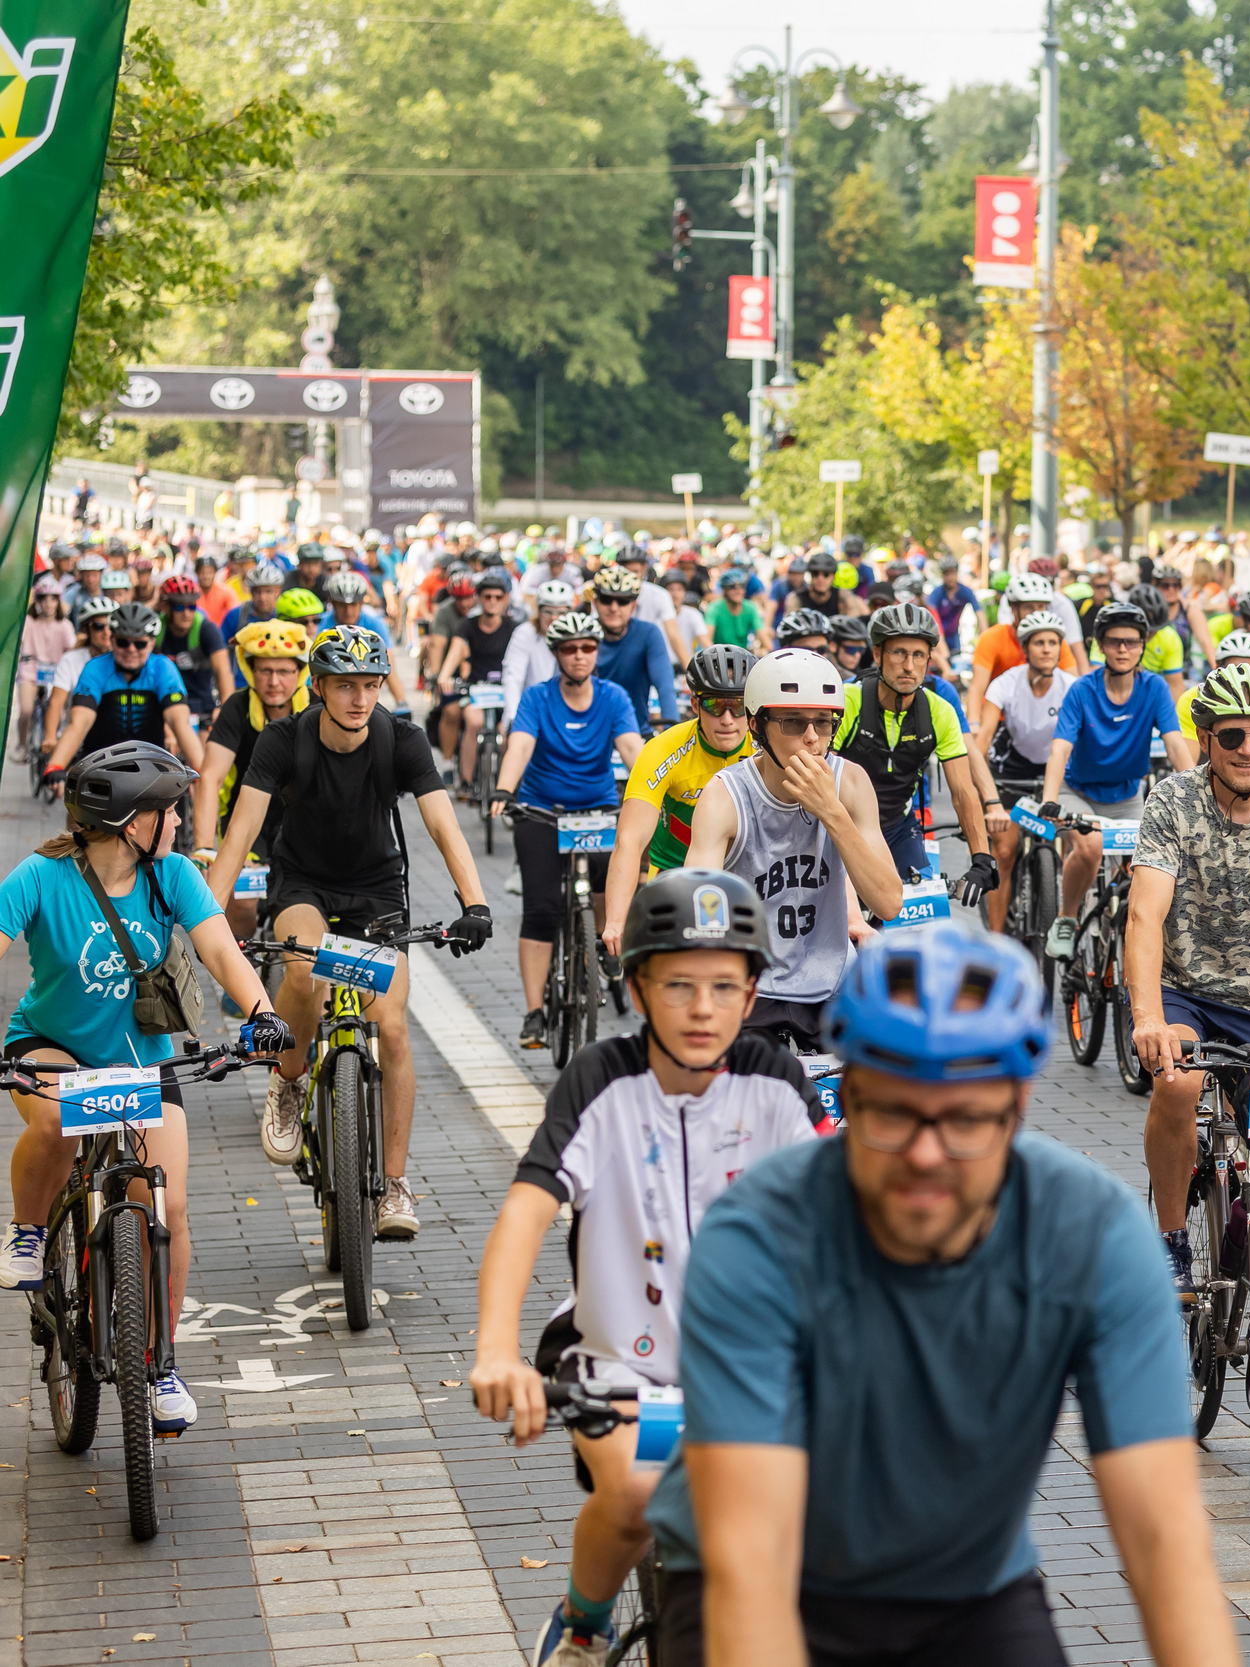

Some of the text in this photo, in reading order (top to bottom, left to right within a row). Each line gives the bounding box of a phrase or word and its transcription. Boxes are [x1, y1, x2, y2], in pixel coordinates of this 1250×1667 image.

[388, 468, 458, 488] TOYOTA
[646, 735, 697, 790] LIETUVA
[1018, 814, 1047, 835] 3270
[754, 854, 831, 901] IBIZA
[777, 904, 817, 939] 03
[898, 903, 935, 921] 4241
[331, 962, 376, 984] 5573
[81, 1092, 141, 1115] 6504
[818, 1089, 836, 1108] 5
